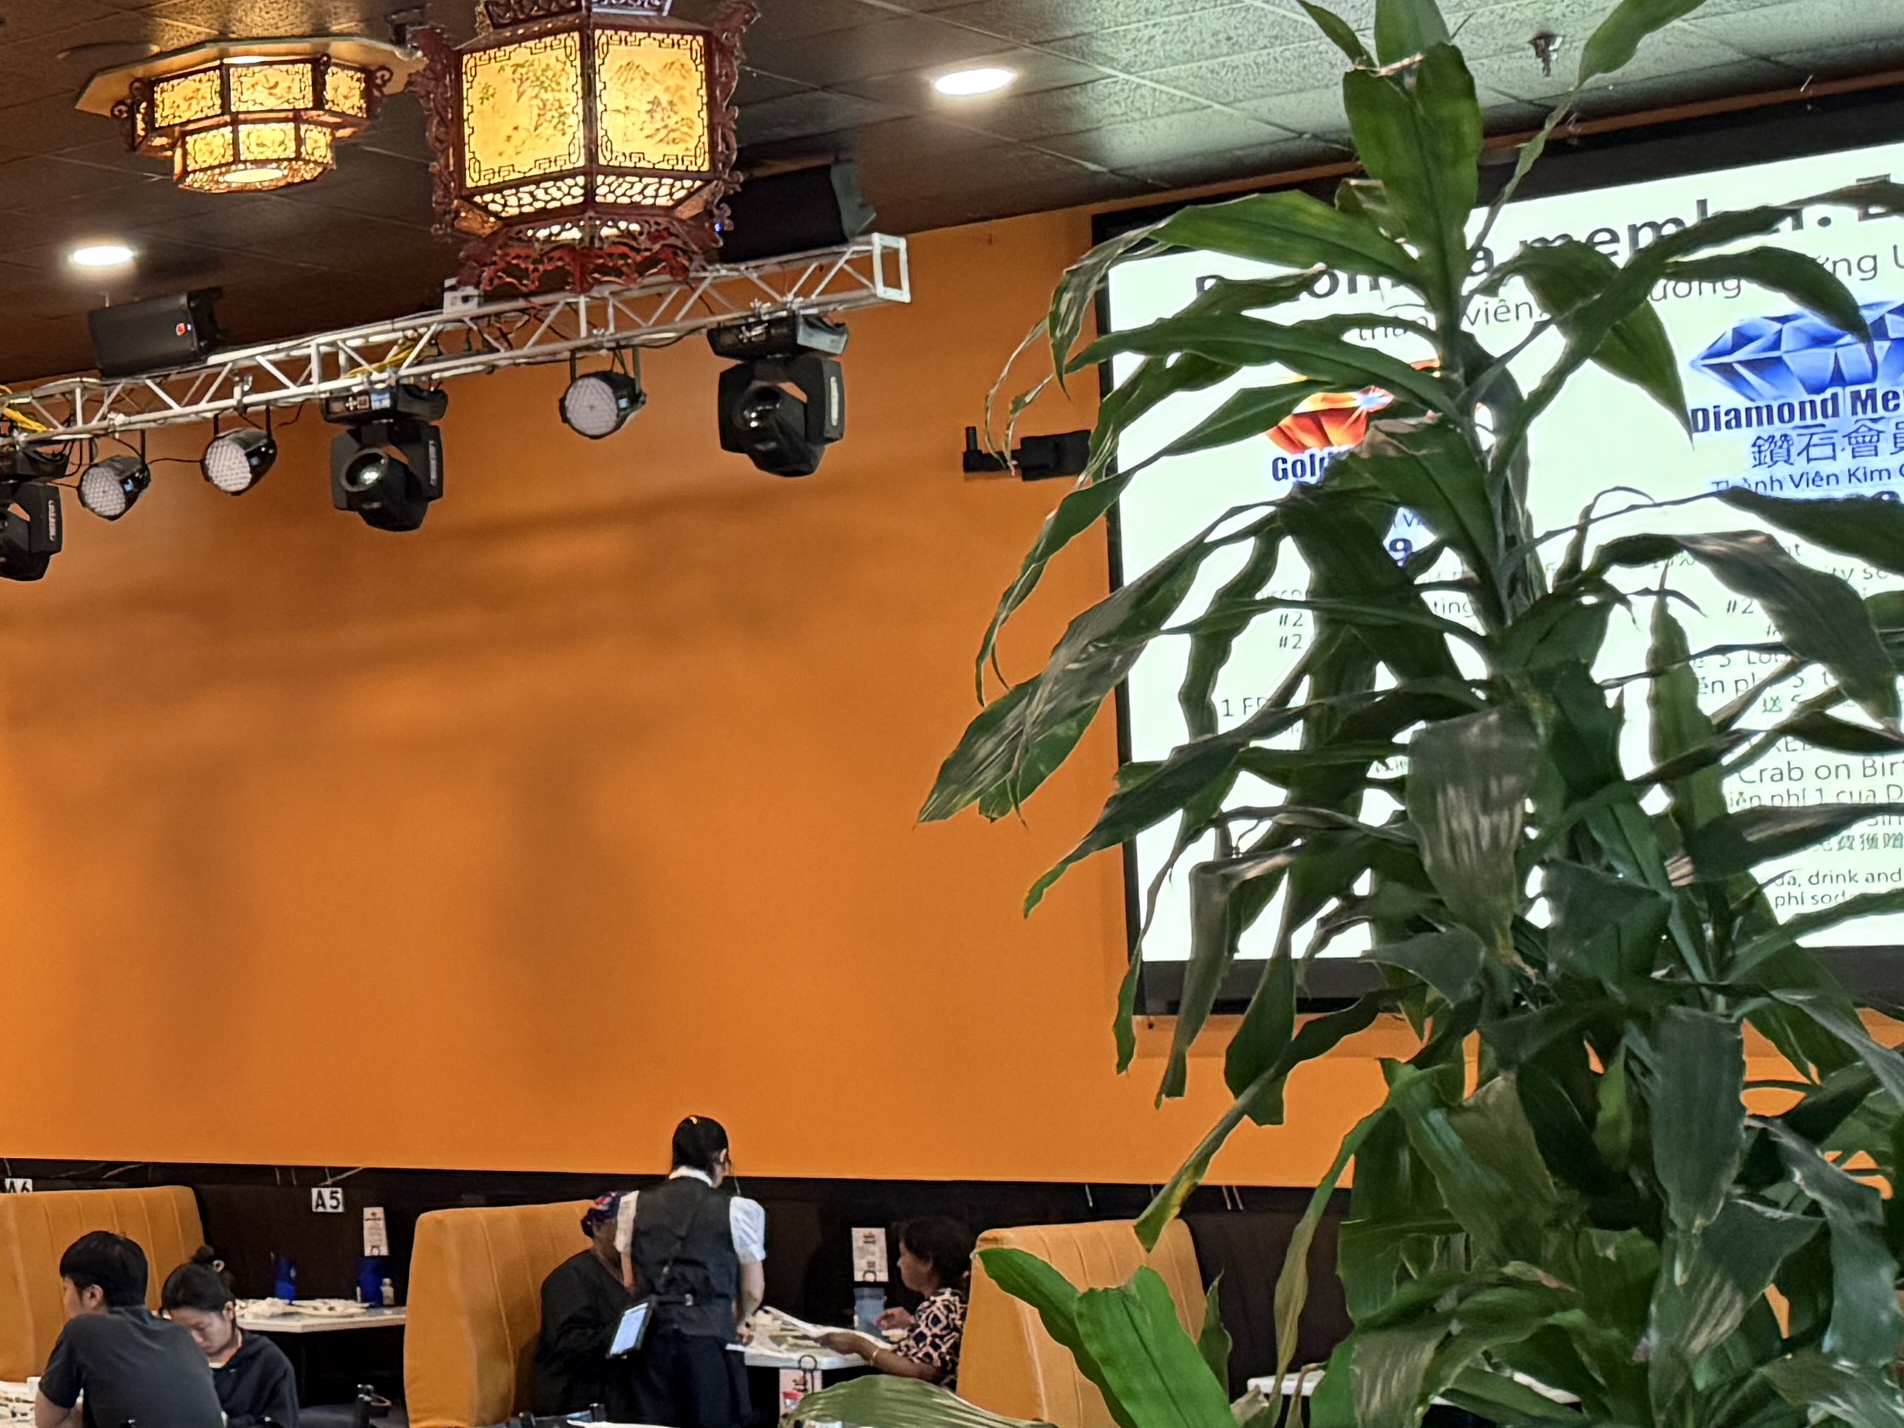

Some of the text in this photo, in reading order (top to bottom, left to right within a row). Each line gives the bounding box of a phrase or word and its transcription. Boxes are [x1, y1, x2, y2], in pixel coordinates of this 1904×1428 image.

[1691, 386, 1904, 434] Diamond Me
[1814, 763, 1851, 781] on
[1808, 869, 1859, 886] drink
[1864, 867, 1902, 883] and
[314, 1188, 342, 1210] A5
